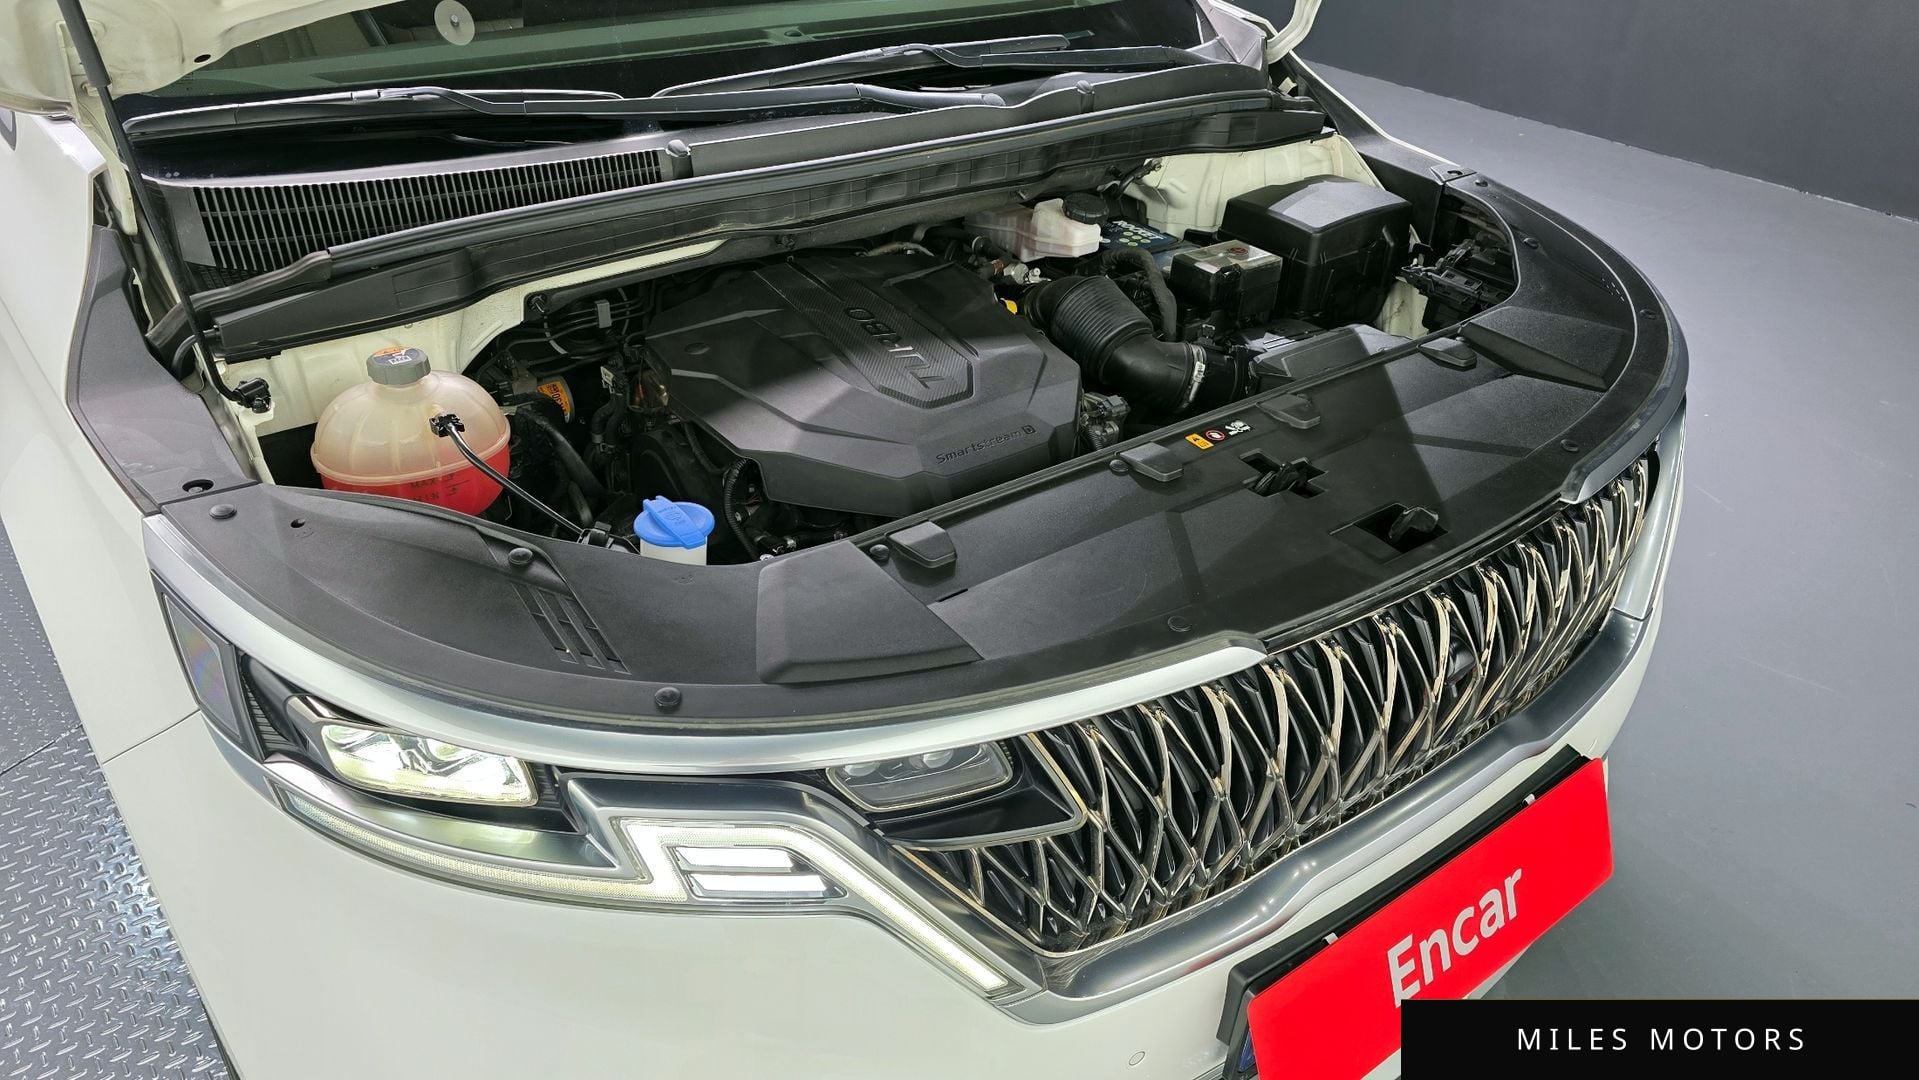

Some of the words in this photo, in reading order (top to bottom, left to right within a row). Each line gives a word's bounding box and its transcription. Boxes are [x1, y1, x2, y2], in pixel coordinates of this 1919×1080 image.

[1111, 219, 1164, 240] ROCKET
[844, 307, 945, 389] TURBO
[935, 430, 1021, 464] Smartstream
[1387, 868, 1522, 1008] Encar
